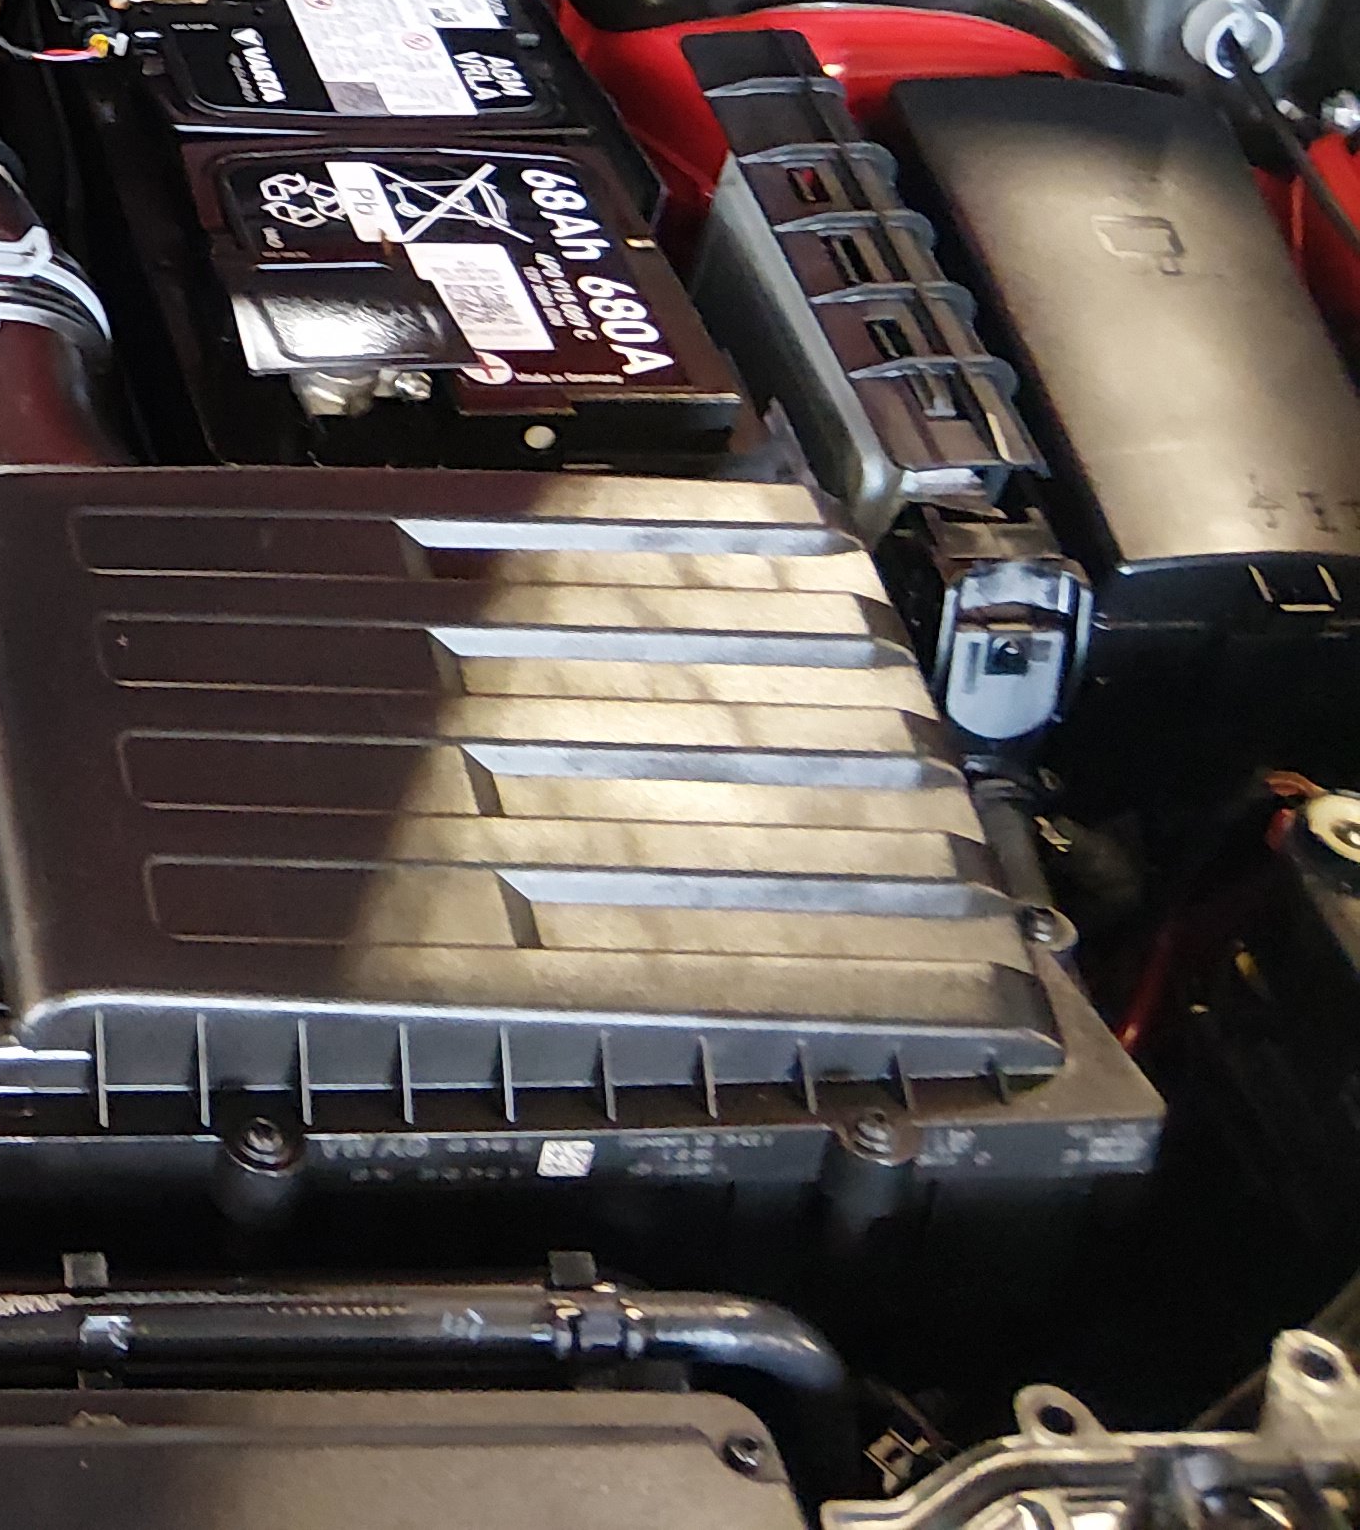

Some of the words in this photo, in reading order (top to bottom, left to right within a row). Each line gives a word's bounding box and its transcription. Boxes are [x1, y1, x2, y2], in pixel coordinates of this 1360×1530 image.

[480, 53, 533, 97] AGM
[348, 187, 380, 216] Pb
[520, 169, 612, 260] 68Ah
[577, 275, 675, 375] 680A
